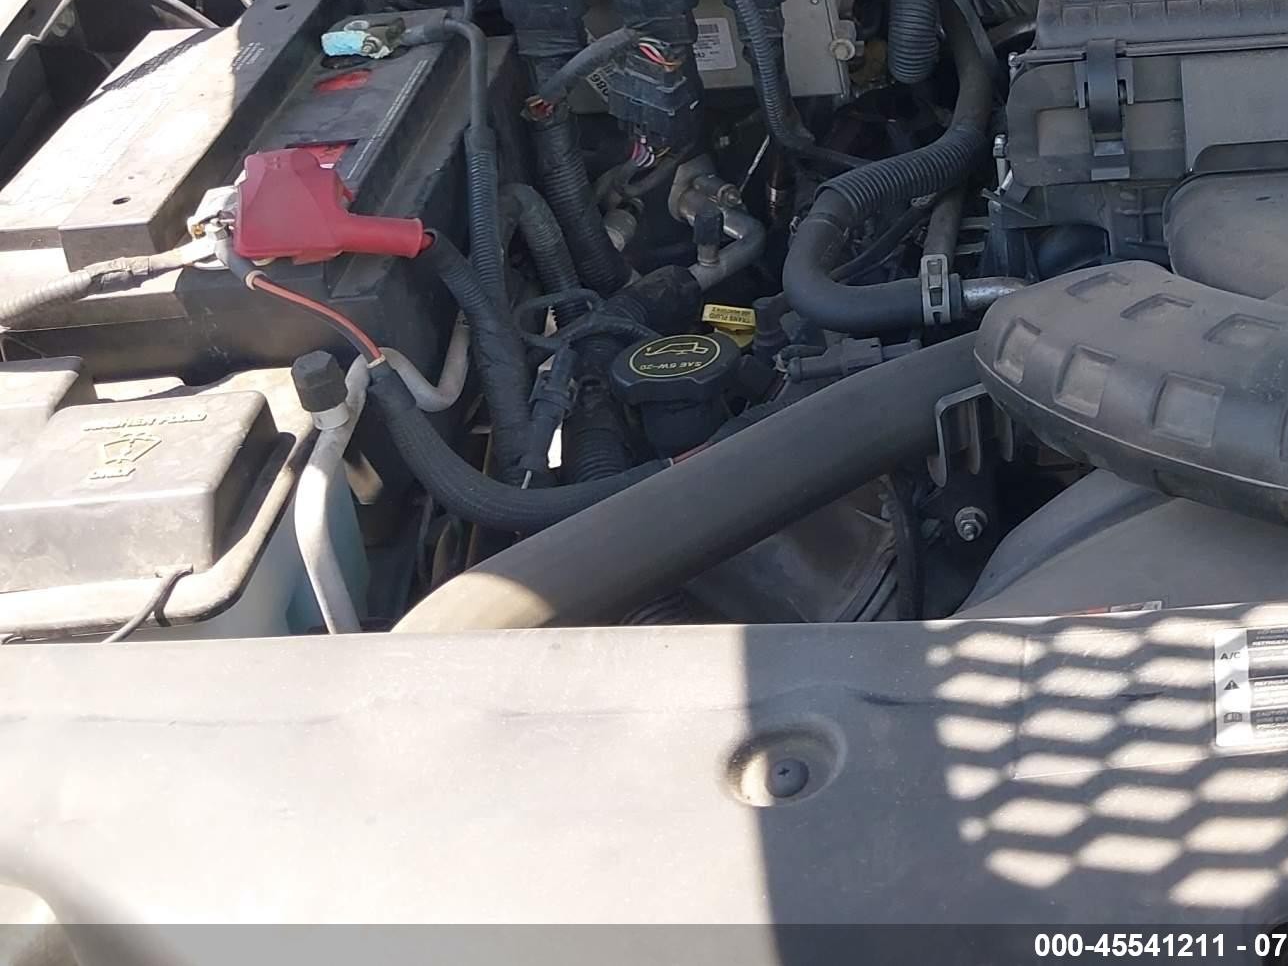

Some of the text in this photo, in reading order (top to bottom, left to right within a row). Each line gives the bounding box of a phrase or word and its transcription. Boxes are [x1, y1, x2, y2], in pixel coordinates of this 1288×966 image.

[638, 360, 703, 371] SAE 5W-20
[1219, 651, 1241, 661] A/C
